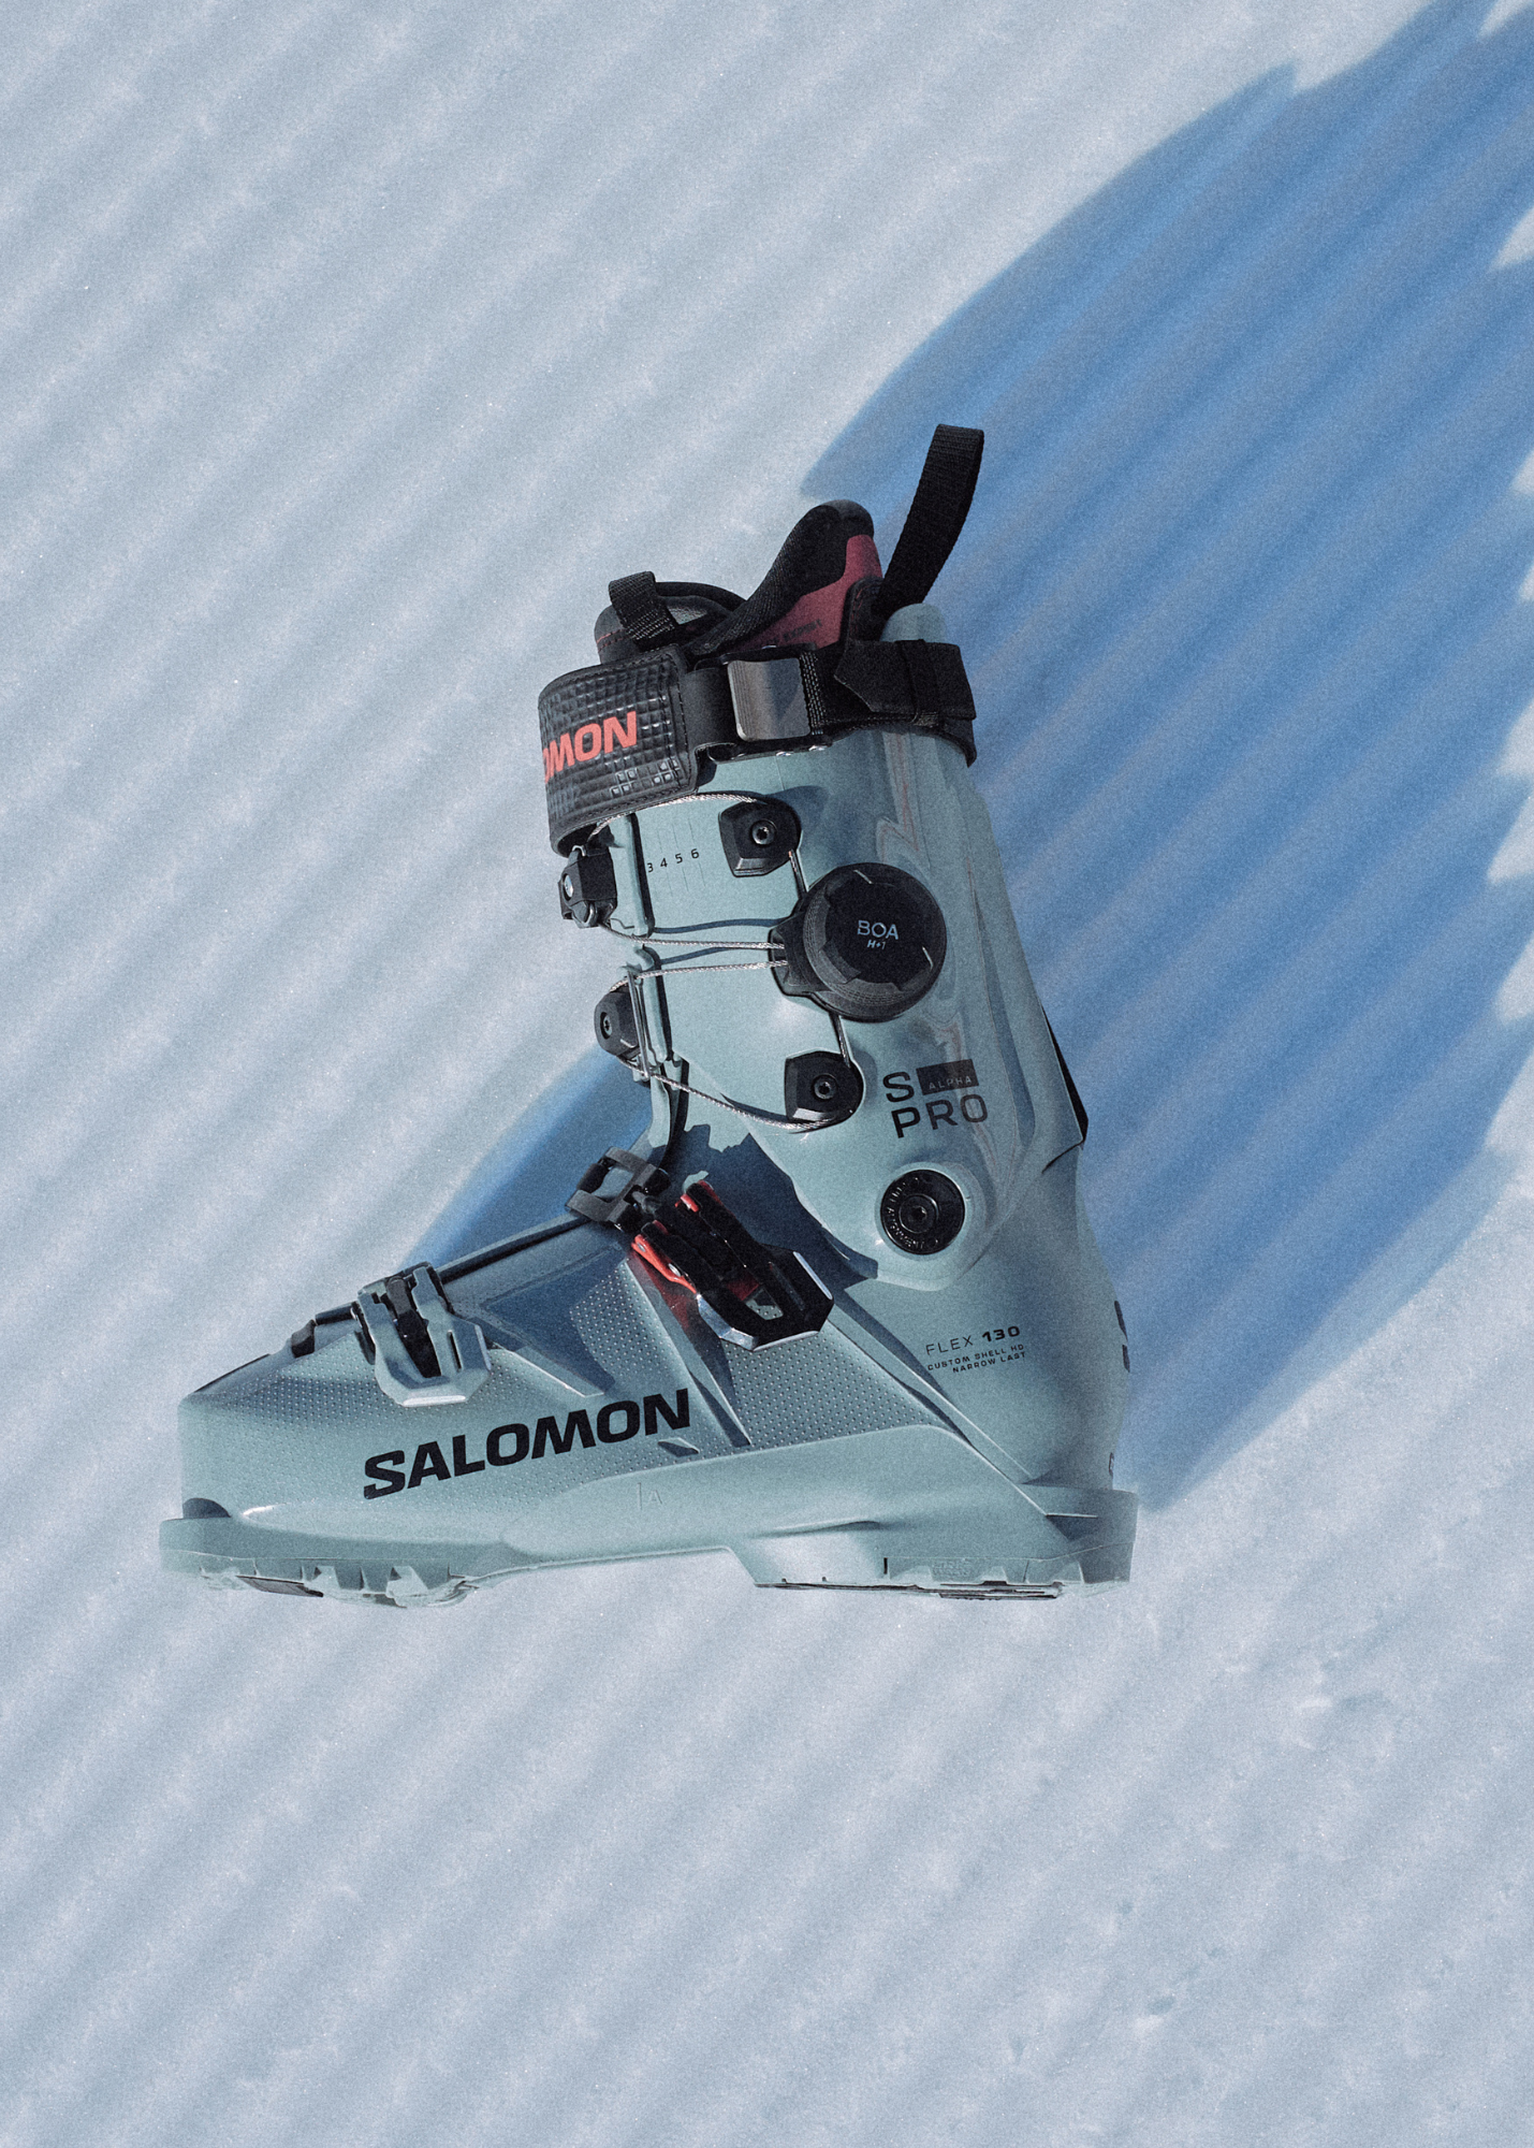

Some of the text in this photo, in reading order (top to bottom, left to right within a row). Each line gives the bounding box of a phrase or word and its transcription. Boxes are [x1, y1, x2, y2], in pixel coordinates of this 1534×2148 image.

[647, 848, 700, 873] 3 4 5 6
[857, 920, 899, 940] BOA
[929, 1075, 972, 1090] ALPHA
[891, 1094, 988, 1139] PRO
[925, 1326, 1020, 1356] FLEX 130
[927, 1343, 1025, 1372] CUSTOM SHELL HD
[952, 1351, 1026, 1374] NARROW LAST
[363, 1388, 691, 1500] SALOMON
